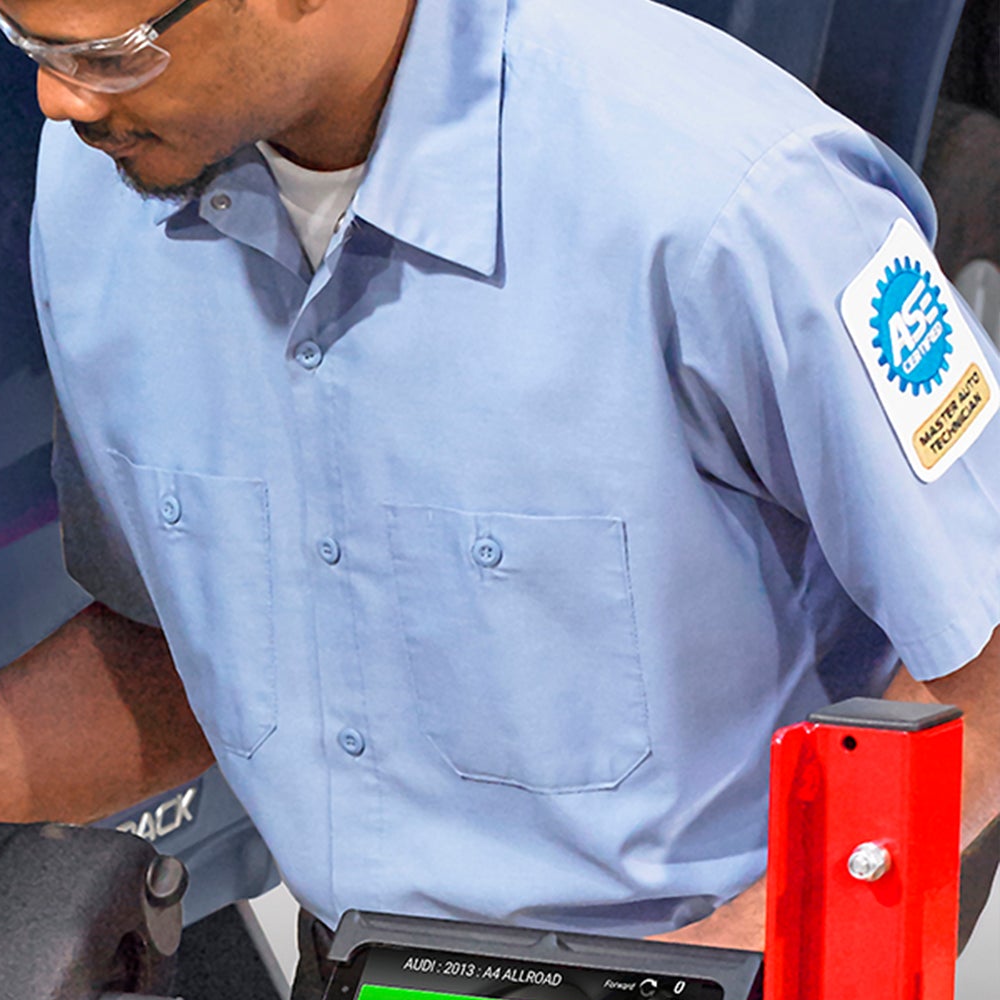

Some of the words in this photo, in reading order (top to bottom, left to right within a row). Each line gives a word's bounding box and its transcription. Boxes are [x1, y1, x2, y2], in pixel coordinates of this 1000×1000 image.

[888, 278, 939, 368] ASE
[919, 400, 958, 446] MASTER
[958, 371, 980, 403] AUTO
[929, 392, 982, 454] TECHNICIAN
[403, 957, 436, 972] AUDI
[443, 961, 476, 977] 2013
[482, 967, 500, 980] A4
[501, 968, 563, 987] ALLROAD
[603, 979, 636, 991] Forward
[673, 980, 686, 994] 0
